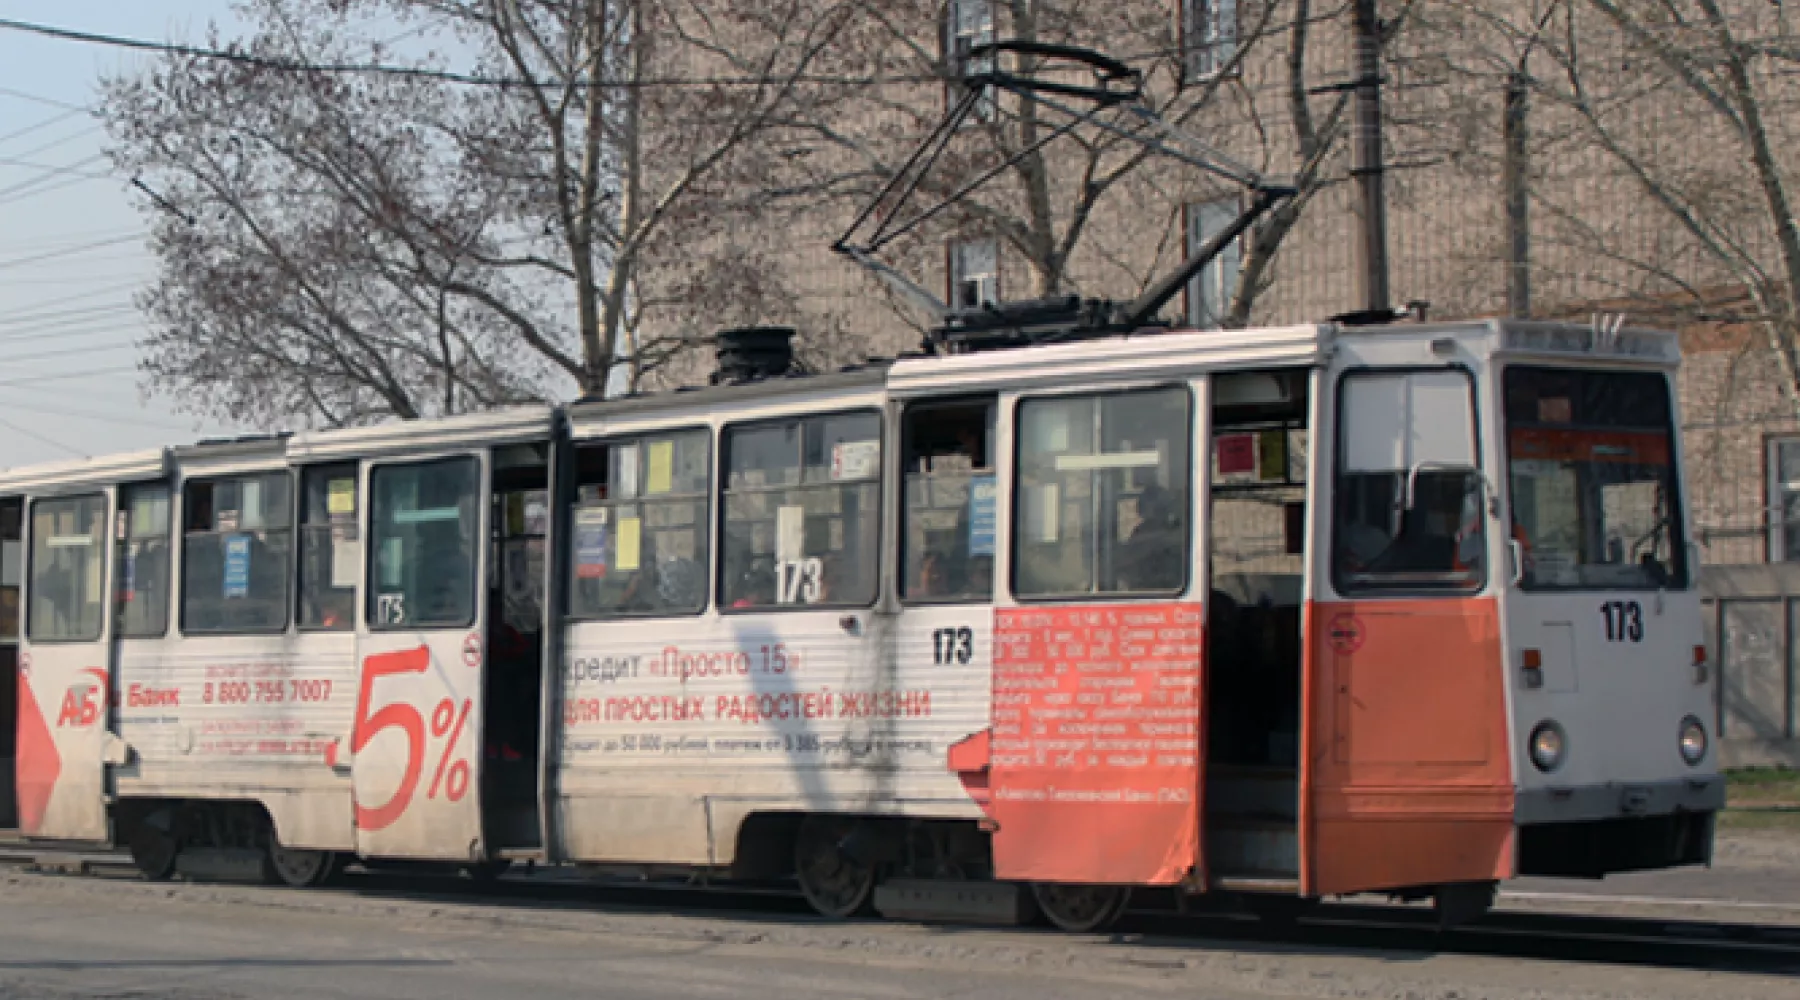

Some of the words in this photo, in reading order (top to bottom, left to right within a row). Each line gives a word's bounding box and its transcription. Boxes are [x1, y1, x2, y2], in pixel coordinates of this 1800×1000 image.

[775, 557, 823, 604] 173
[1599, 600, 1644, 642] 173
[649, 645, 750, 684] «Просто
[932, 625, 973, 665] 173
[128, 682, 181, 708] Банк
[203, 682, 214, 704] 8
[219, 682, 249, 704] 800
[290, 679, 333, 702] 7007
[604, 695, 705, 722] ПРОСТЫХ
[715, 685, 834, 724] РАДОСТЕЙ
[838, 689, 932, 718] ЖИЗНИ
